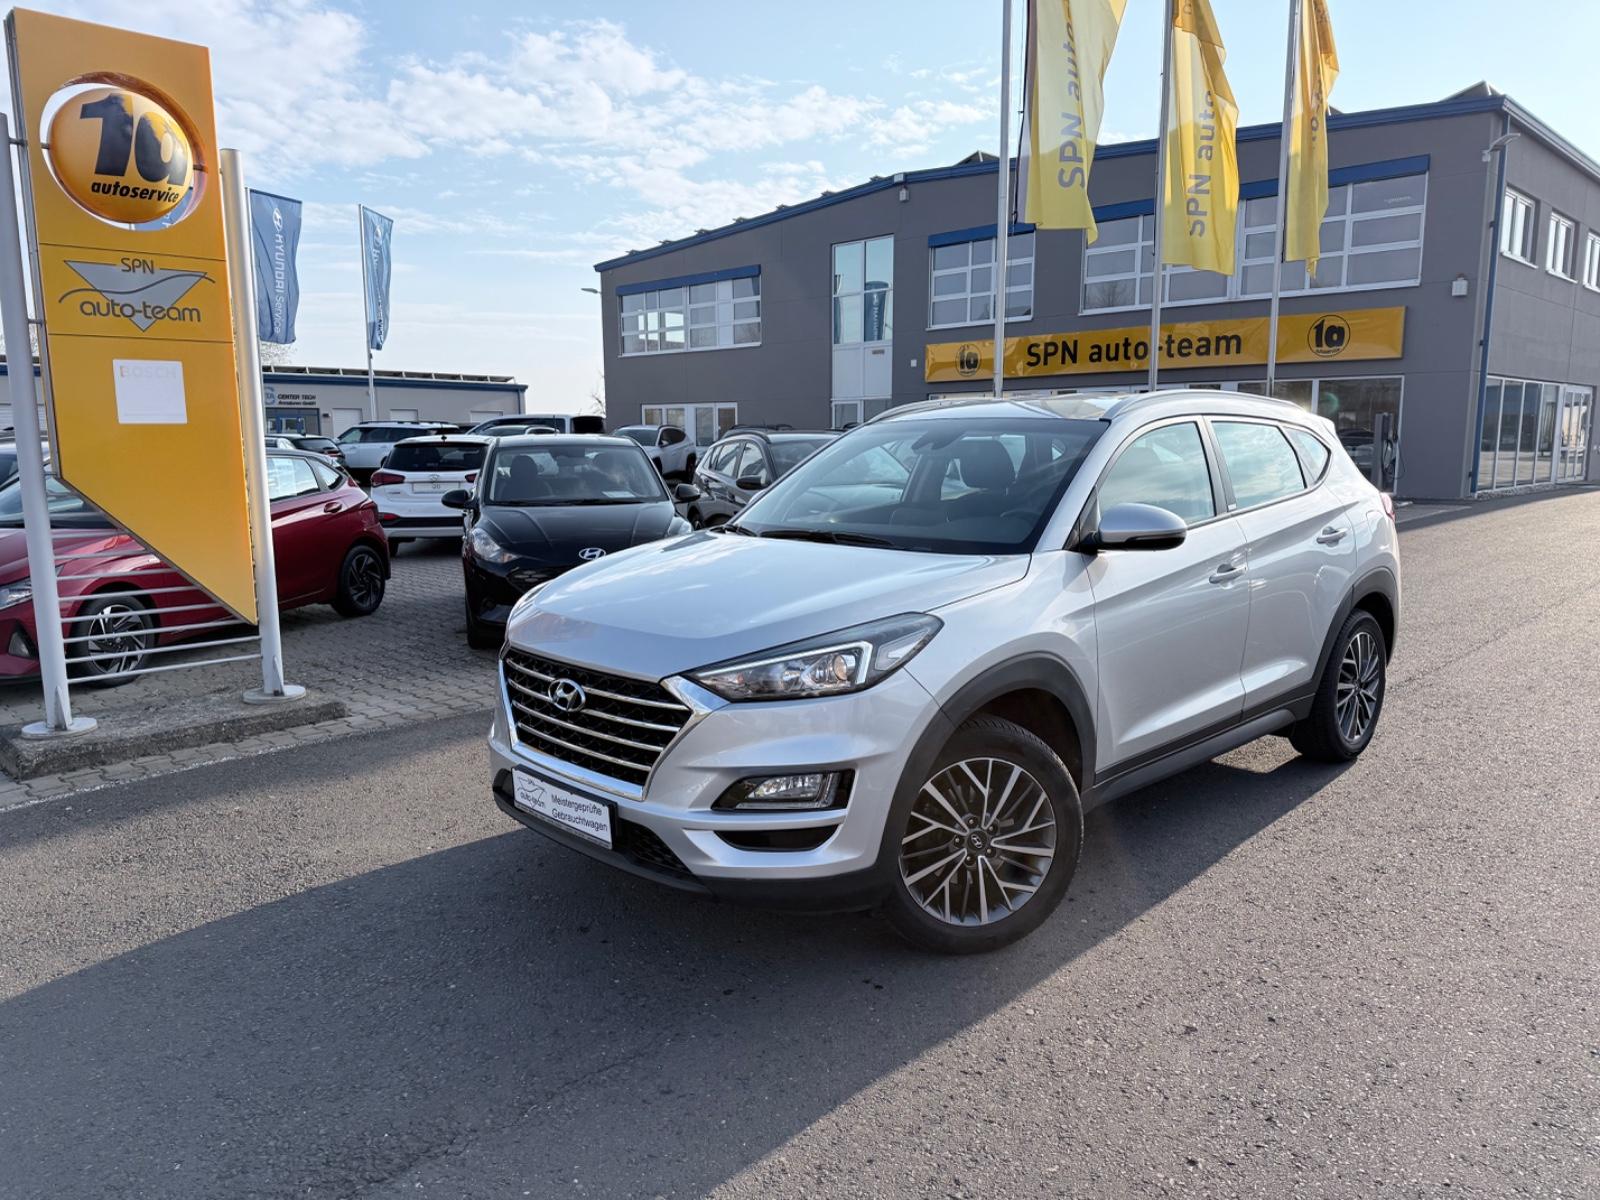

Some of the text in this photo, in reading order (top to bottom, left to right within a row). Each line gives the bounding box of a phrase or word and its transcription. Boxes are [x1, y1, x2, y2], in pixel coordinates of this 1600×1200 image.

[80, 93, 188, 186] 1a
[1058, 112, 1086, 189] SPN
[91, 181, 180, 203] autoservice
[1186, 174, 1211, 239] SPN
[121, 257, 155, 274] SPN
[274, 234, 285, 334] HYUNDAI Service
[80, 299, 201, 322] auto-team
[1313, 319, 1345, 348] 1a
[1026, 339, 1079, 367] SPN
[551, 808, 608, 831] Gebrauchtwagen
